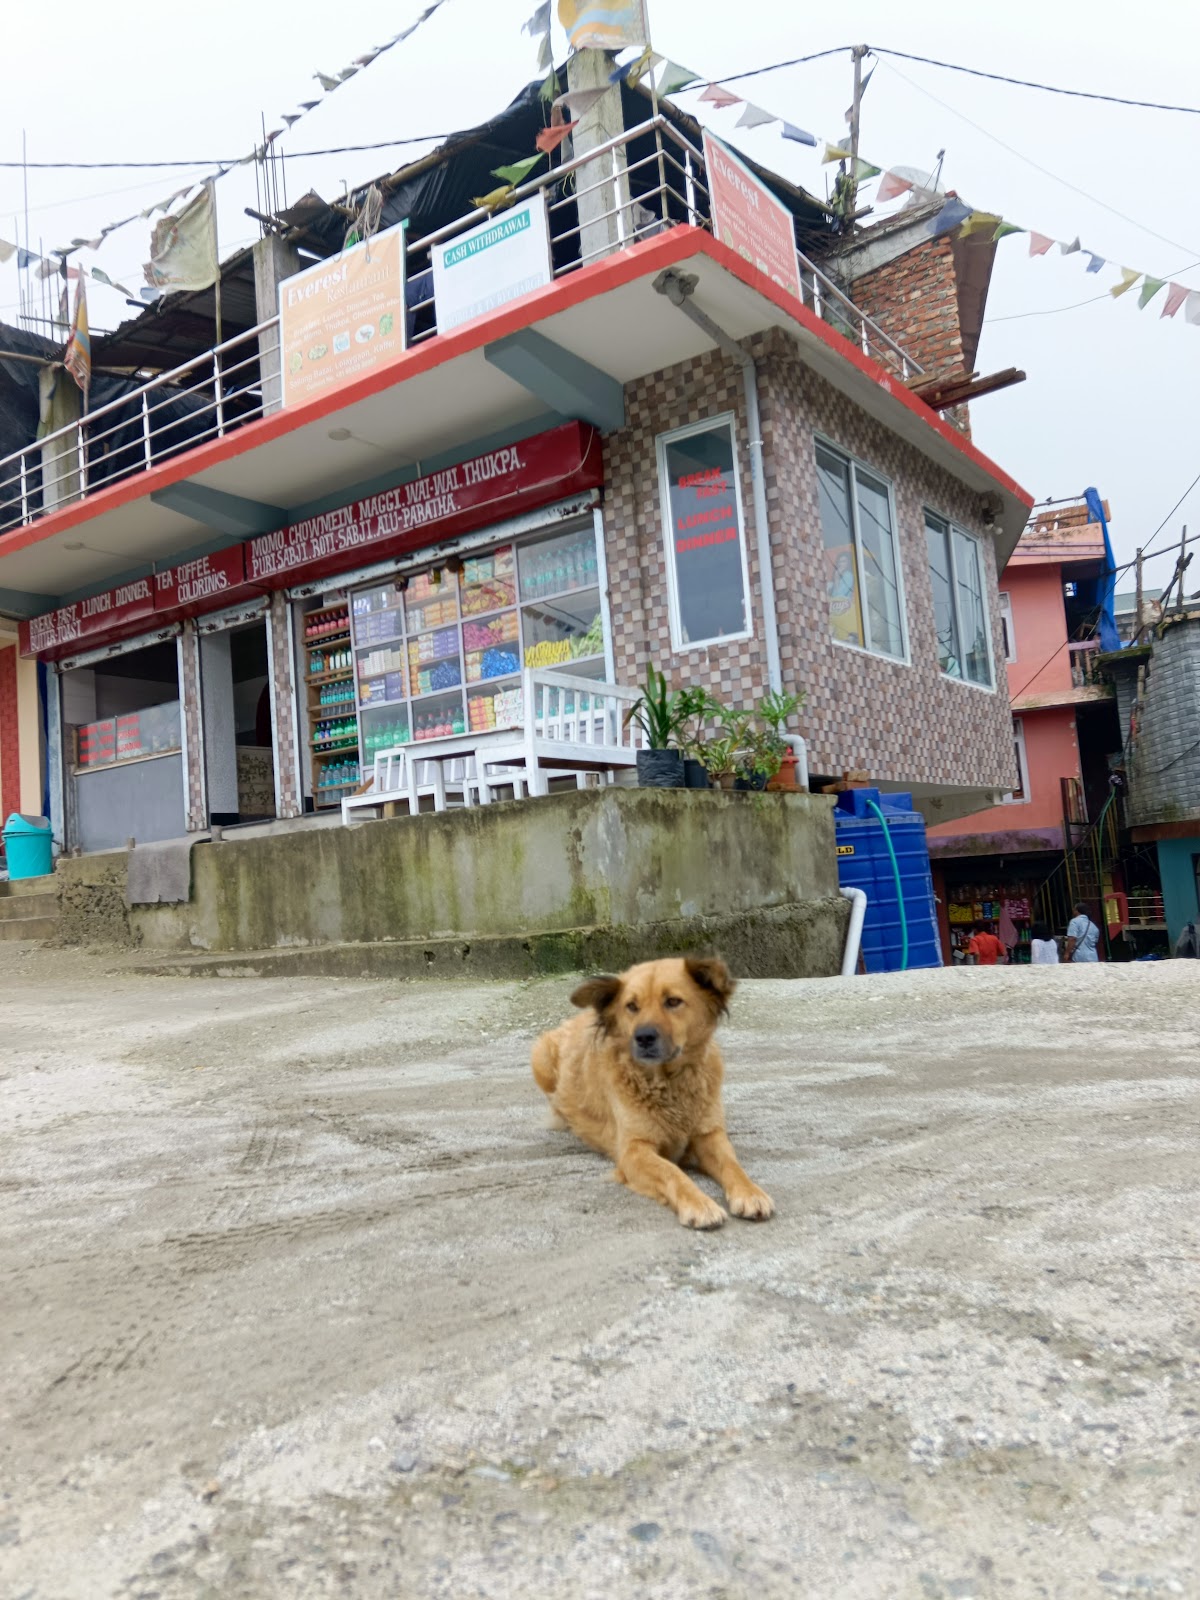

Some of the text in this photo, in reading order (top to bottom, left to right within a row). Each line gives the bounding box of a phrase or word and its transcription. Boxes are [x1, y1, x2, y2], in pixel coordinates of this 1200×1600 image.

[711, 145, 760, 210] Everest
[445, 214, 529, 266] CASH WITHDRAWAL
[287, 263, 348, 308] Everest
[462, 446, 526, 486] THUKPA.
[678, 466, 722, 489] BREAK
[696, 480, 727, 500] FAST
[678, 505, 732, 529] LUNCH
[675, 526, 737, 553] DINNER
